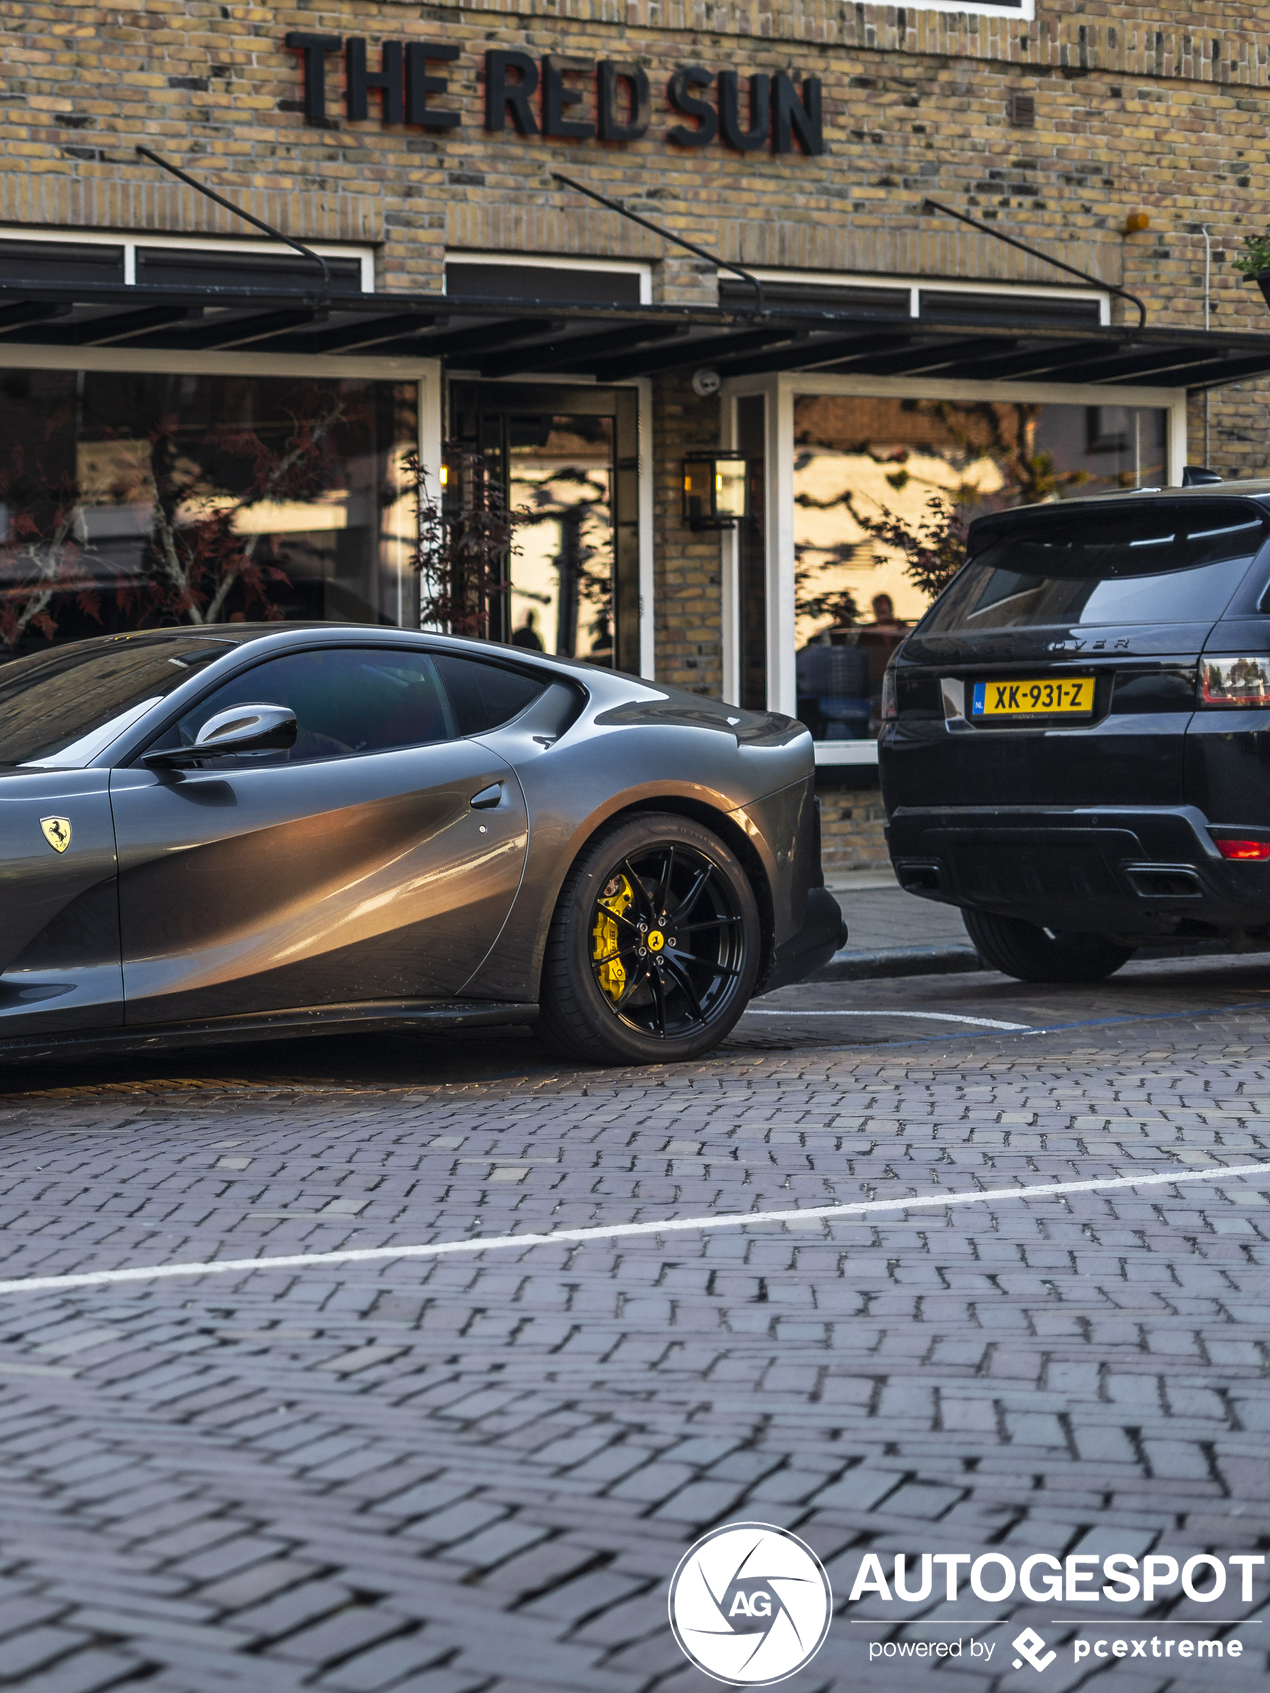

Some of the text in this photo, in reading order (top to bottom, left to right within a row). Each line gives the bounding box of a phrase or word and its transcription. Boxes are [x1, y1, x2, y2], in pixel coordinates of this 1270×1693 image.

[285, 31, 825, 156] THE RED SUN
[975, 701, 983, 709] NL
[994, 683, 1084, 709] XK-931-Z
